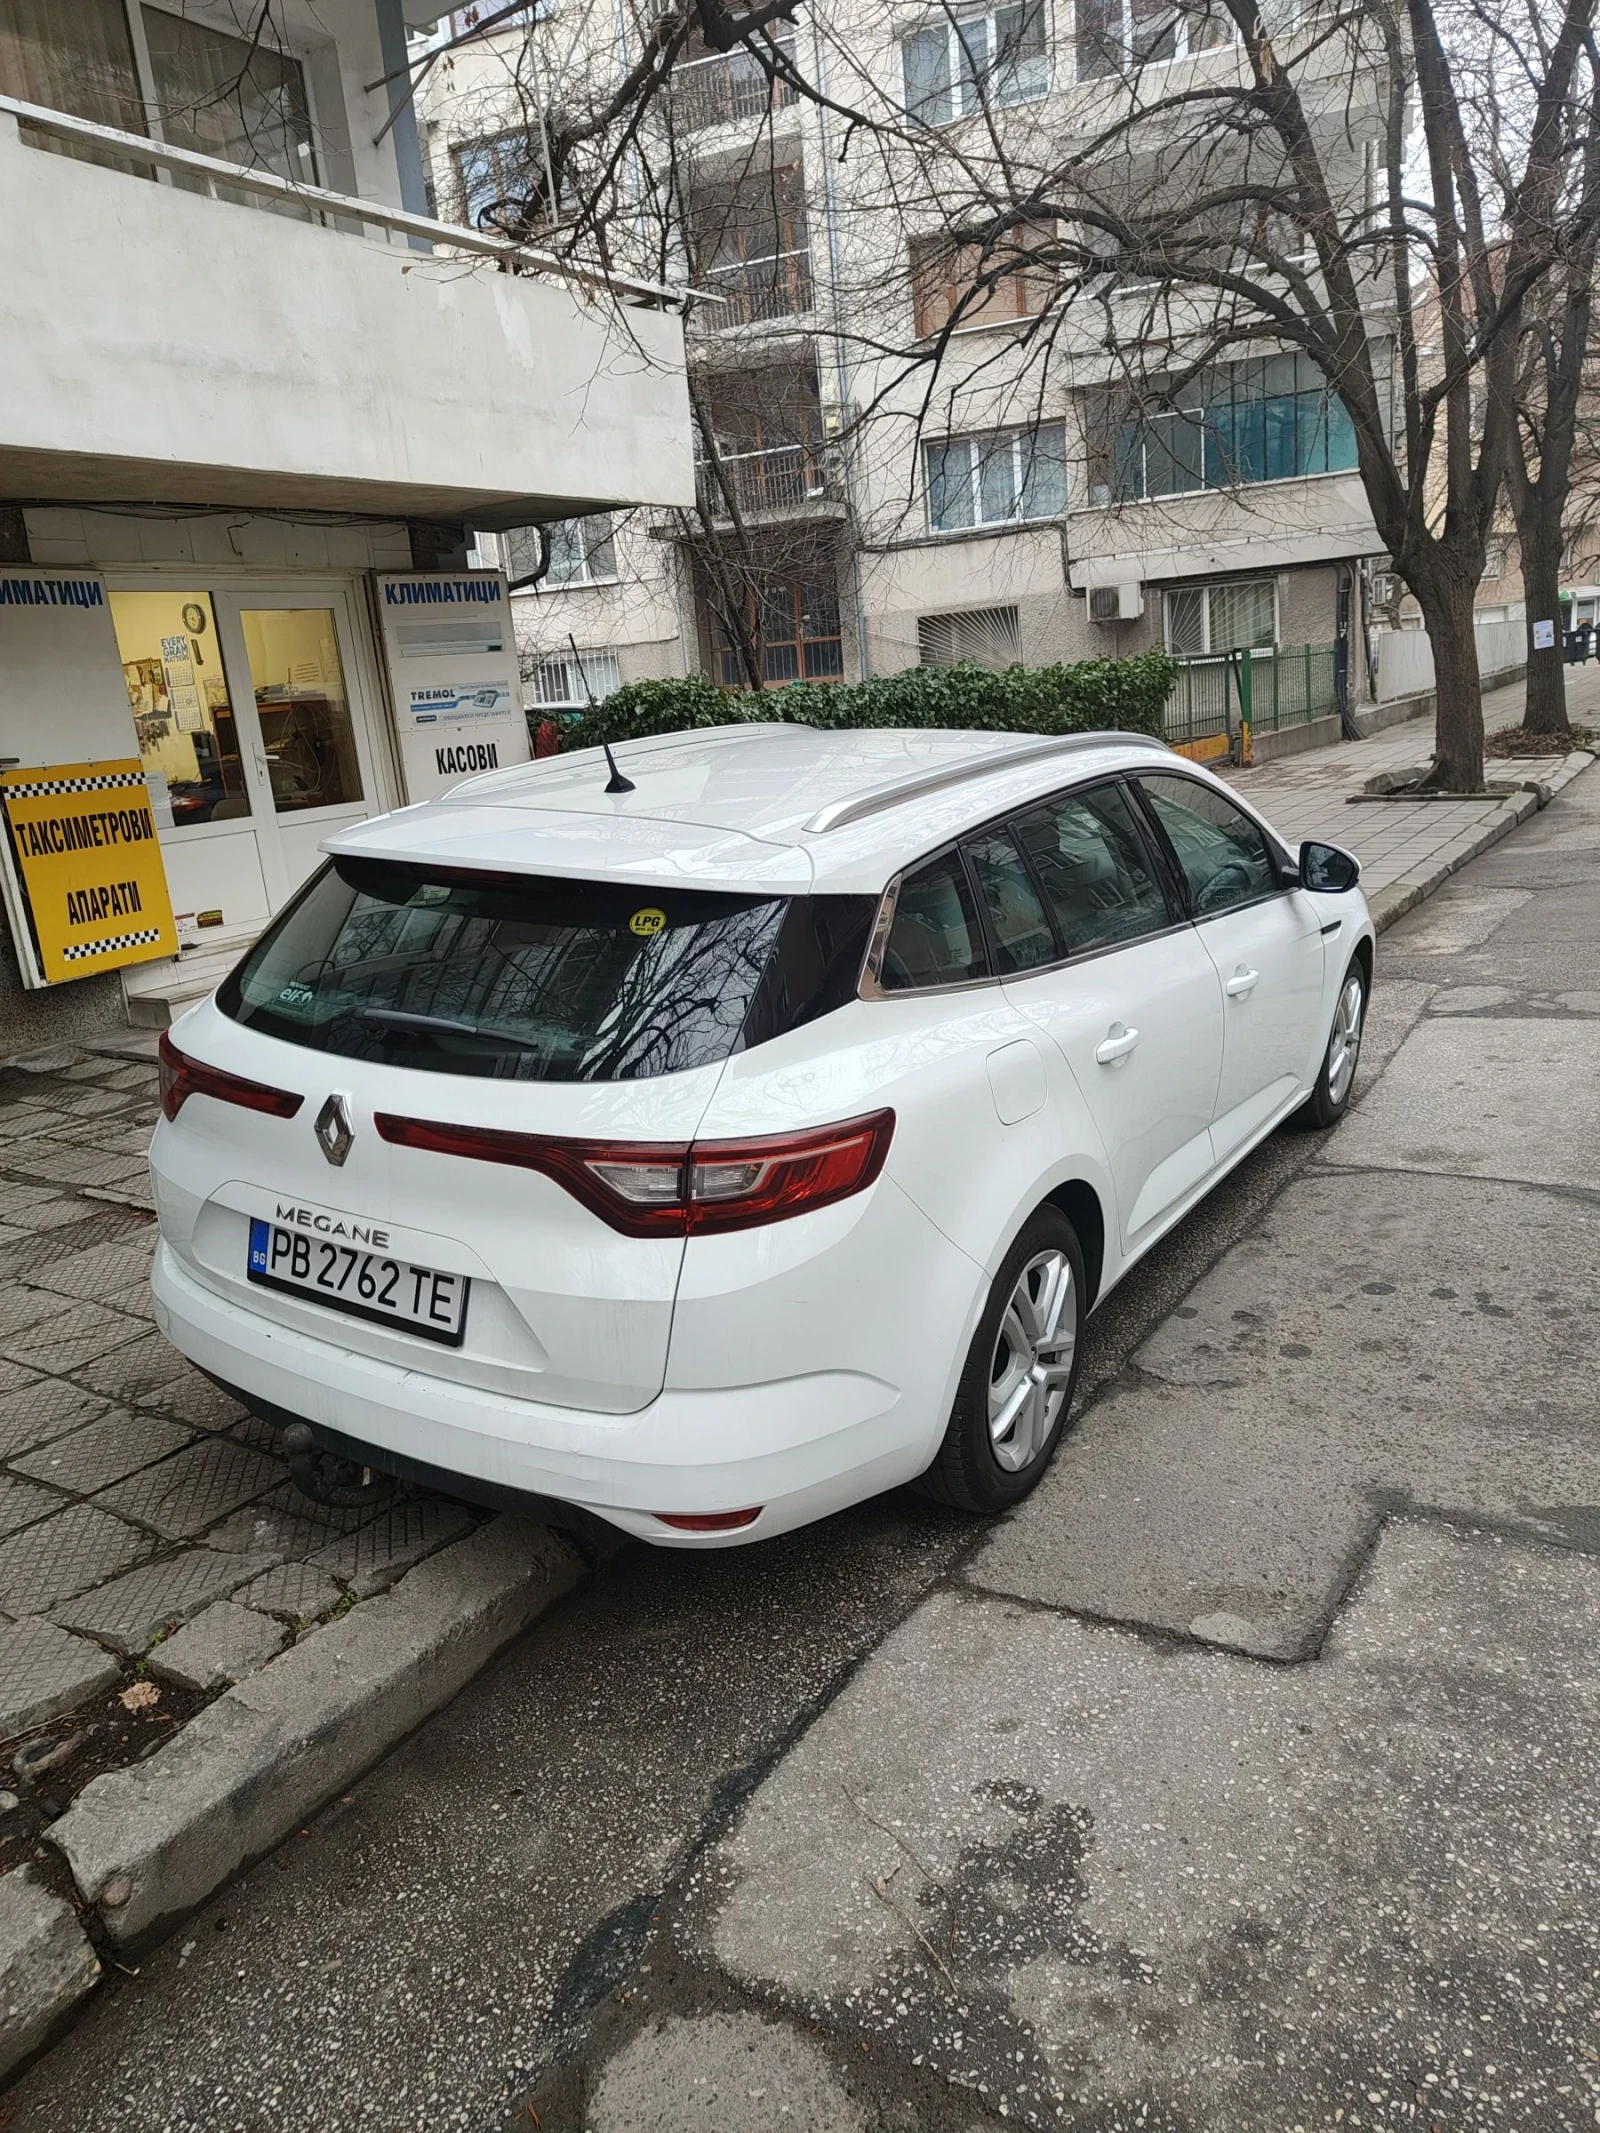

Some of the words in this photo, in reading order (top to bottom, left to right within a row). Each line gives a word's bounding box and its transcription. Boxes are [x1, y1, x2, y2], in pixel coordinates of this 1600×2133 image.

[385, 581, 501, 604] КЛИМАТИЦИ
[161, 635, 186, 647] EVERY
[163, 644, 189, 657] GRAM
[164, 654, 190, 664] MATTERS
[410, 689, 456, 701] TREMOL
[435, 743, 498, 775] КАСОВИ
[15, 808, 153, 857] ТАКСИМЕТРОВИ
[66, 881, 141, 925] АПАРАТИ
[634, 915, 661, 927] LPG
[275, 1203, 390, 1249] MEGANE
[253, 1250, 266, 1265] BG
[271, 1227, 311, 1279] PB
[317, 1243, 400, 1307] 2762
[409, 1266, 454, 1323] TE
